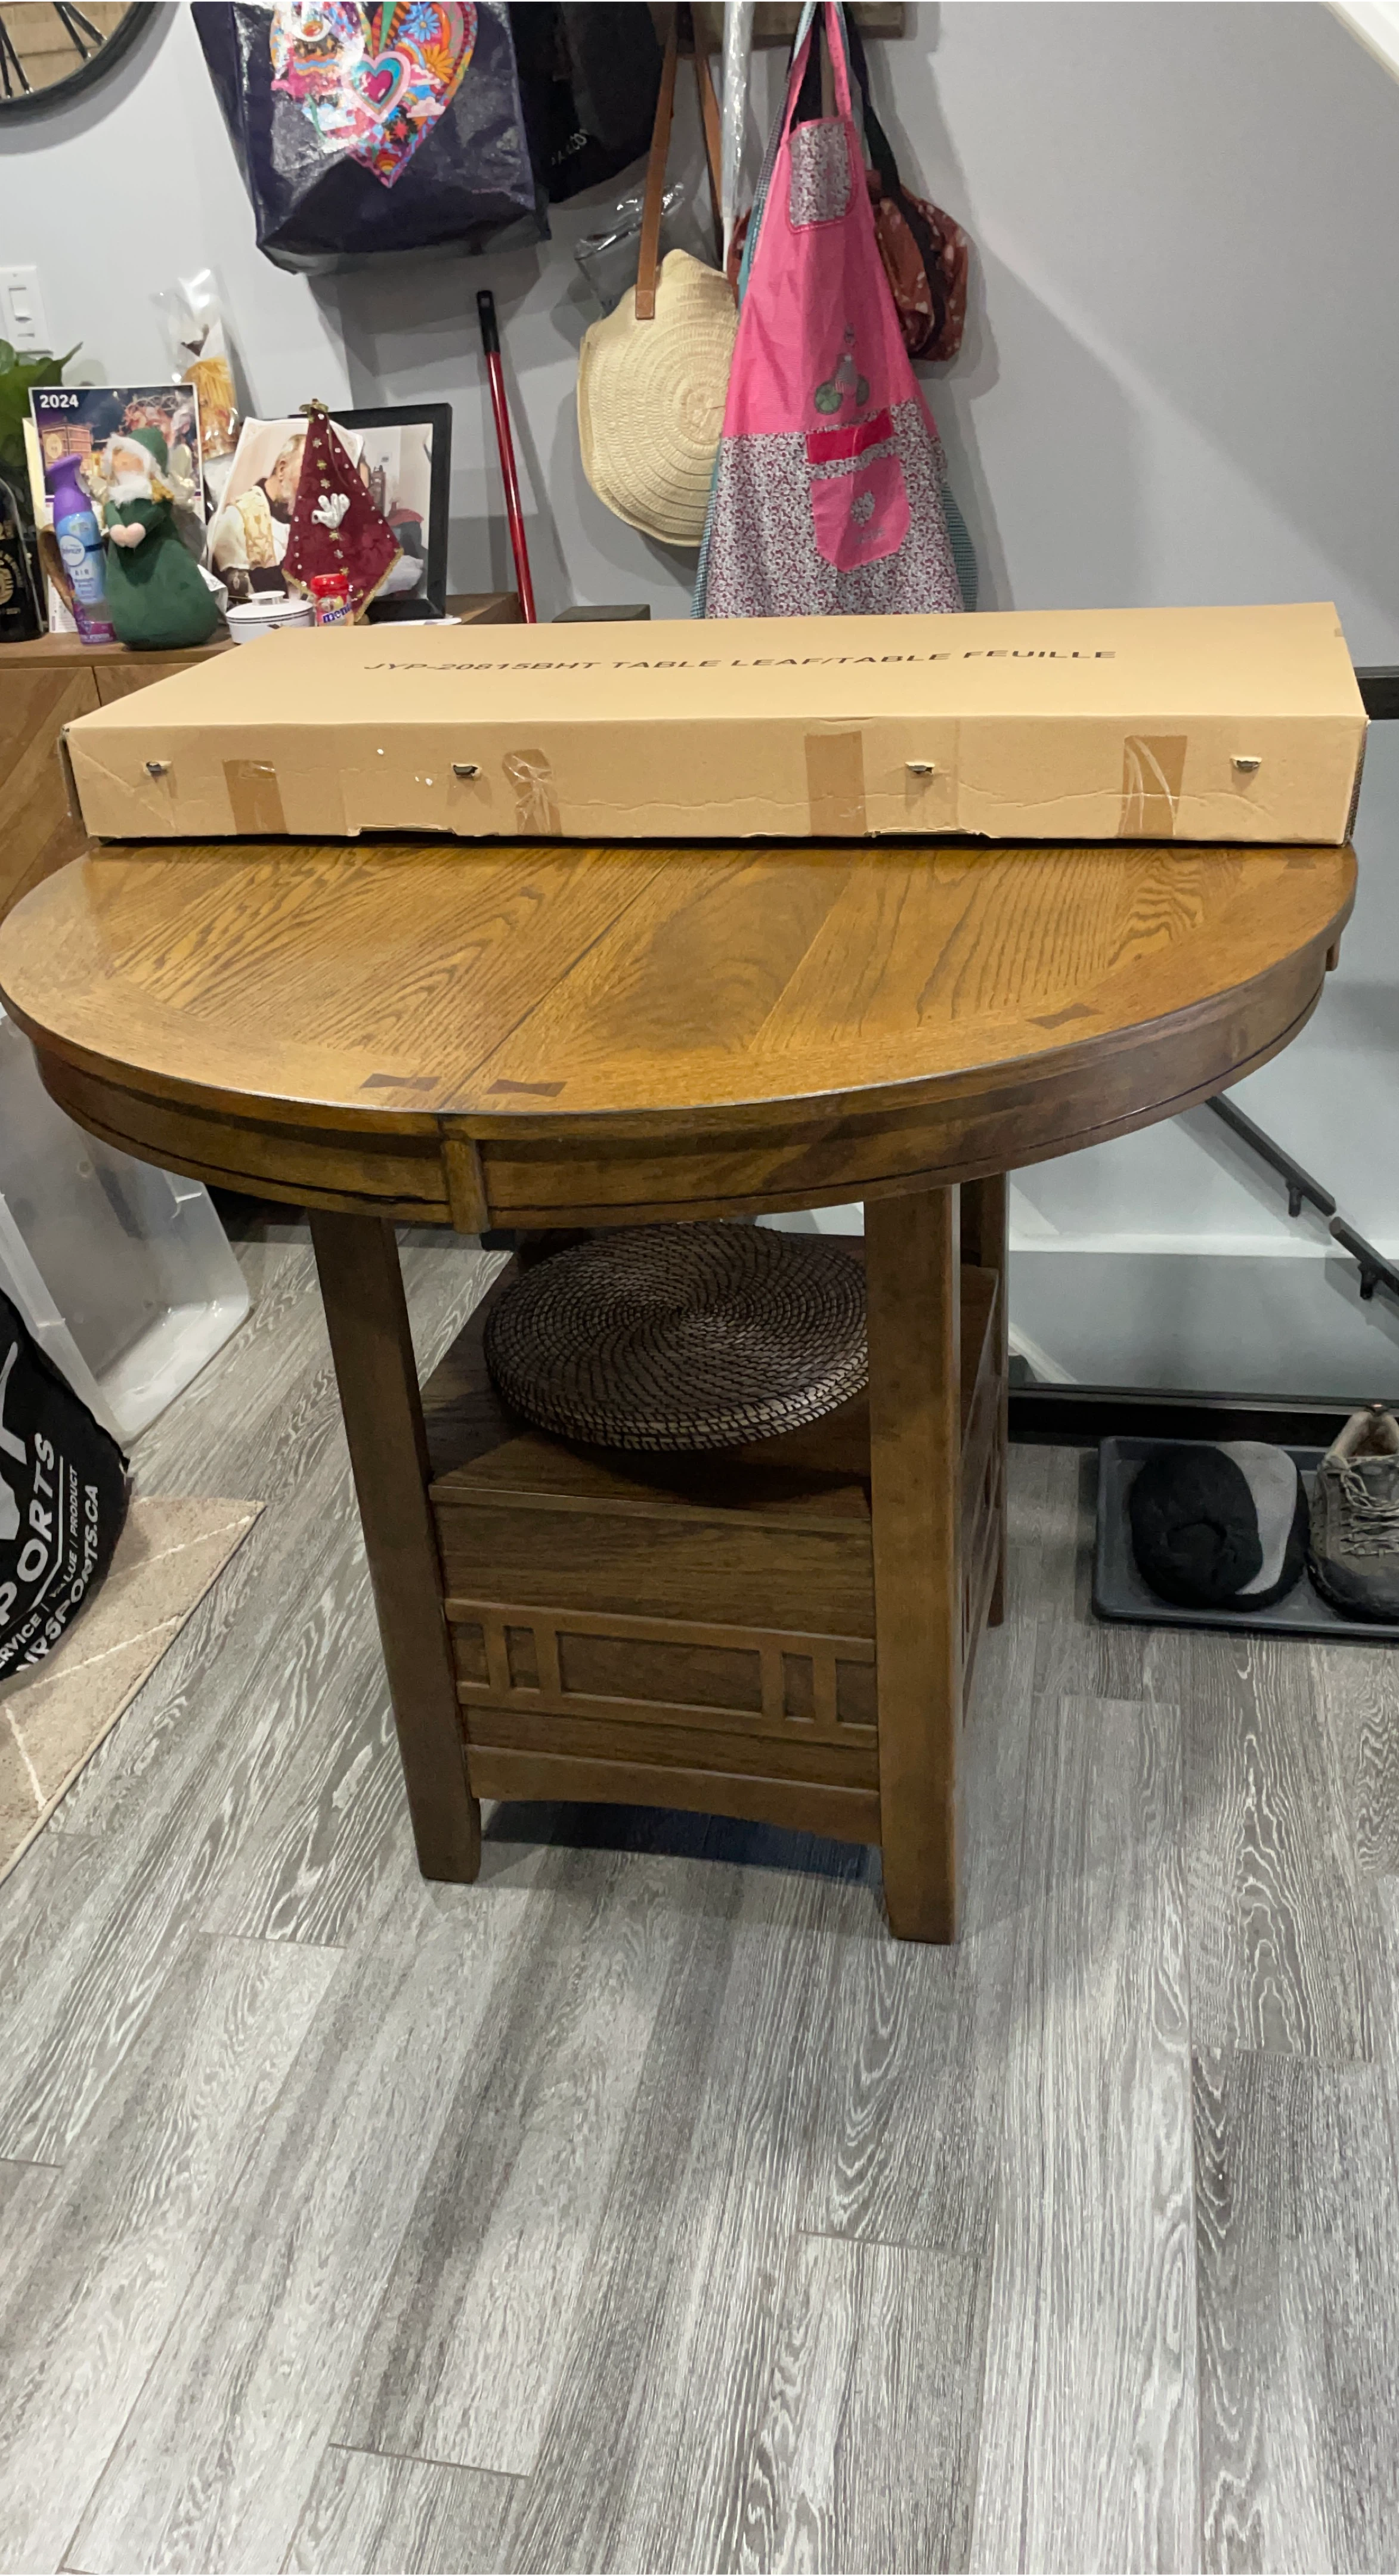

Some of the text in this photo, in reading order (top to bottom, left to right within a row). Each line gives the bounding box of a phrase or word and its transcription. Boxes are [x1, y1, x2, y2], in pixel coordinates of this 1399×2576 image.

[39, 394, 79, 408] 2024
[612, 660, 722, 668] TABLE
[731, 653, 952, 667] LEAF/TABLE
[963, 650, 1116, 659] FEUILLE
[70, 1463, 78, 1537] PRODUCT
